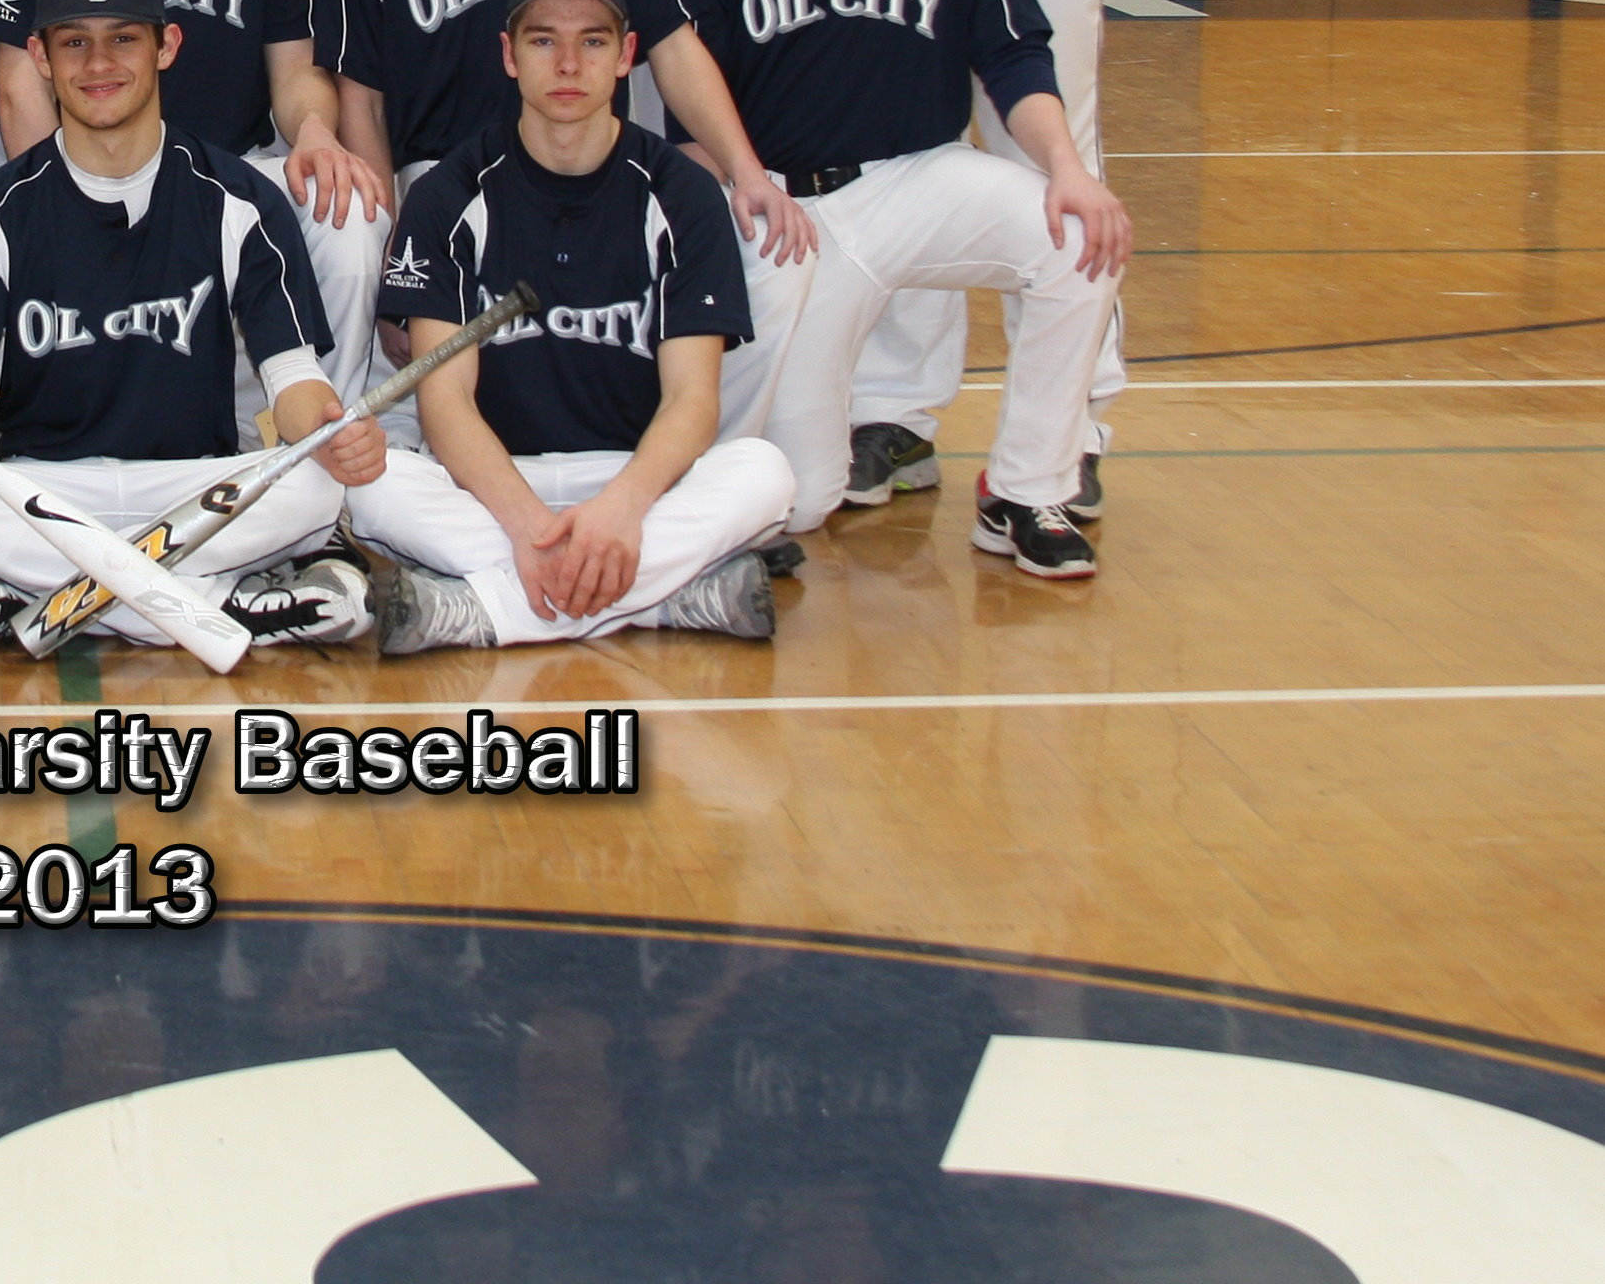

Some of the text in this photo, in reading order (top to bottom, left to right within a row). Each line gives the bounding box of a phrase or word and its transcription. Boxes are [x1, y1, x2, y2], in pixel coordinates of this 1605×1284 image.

[17, 274, 215, 359] OL CITY
[547, 283, 655, 361] CITY
